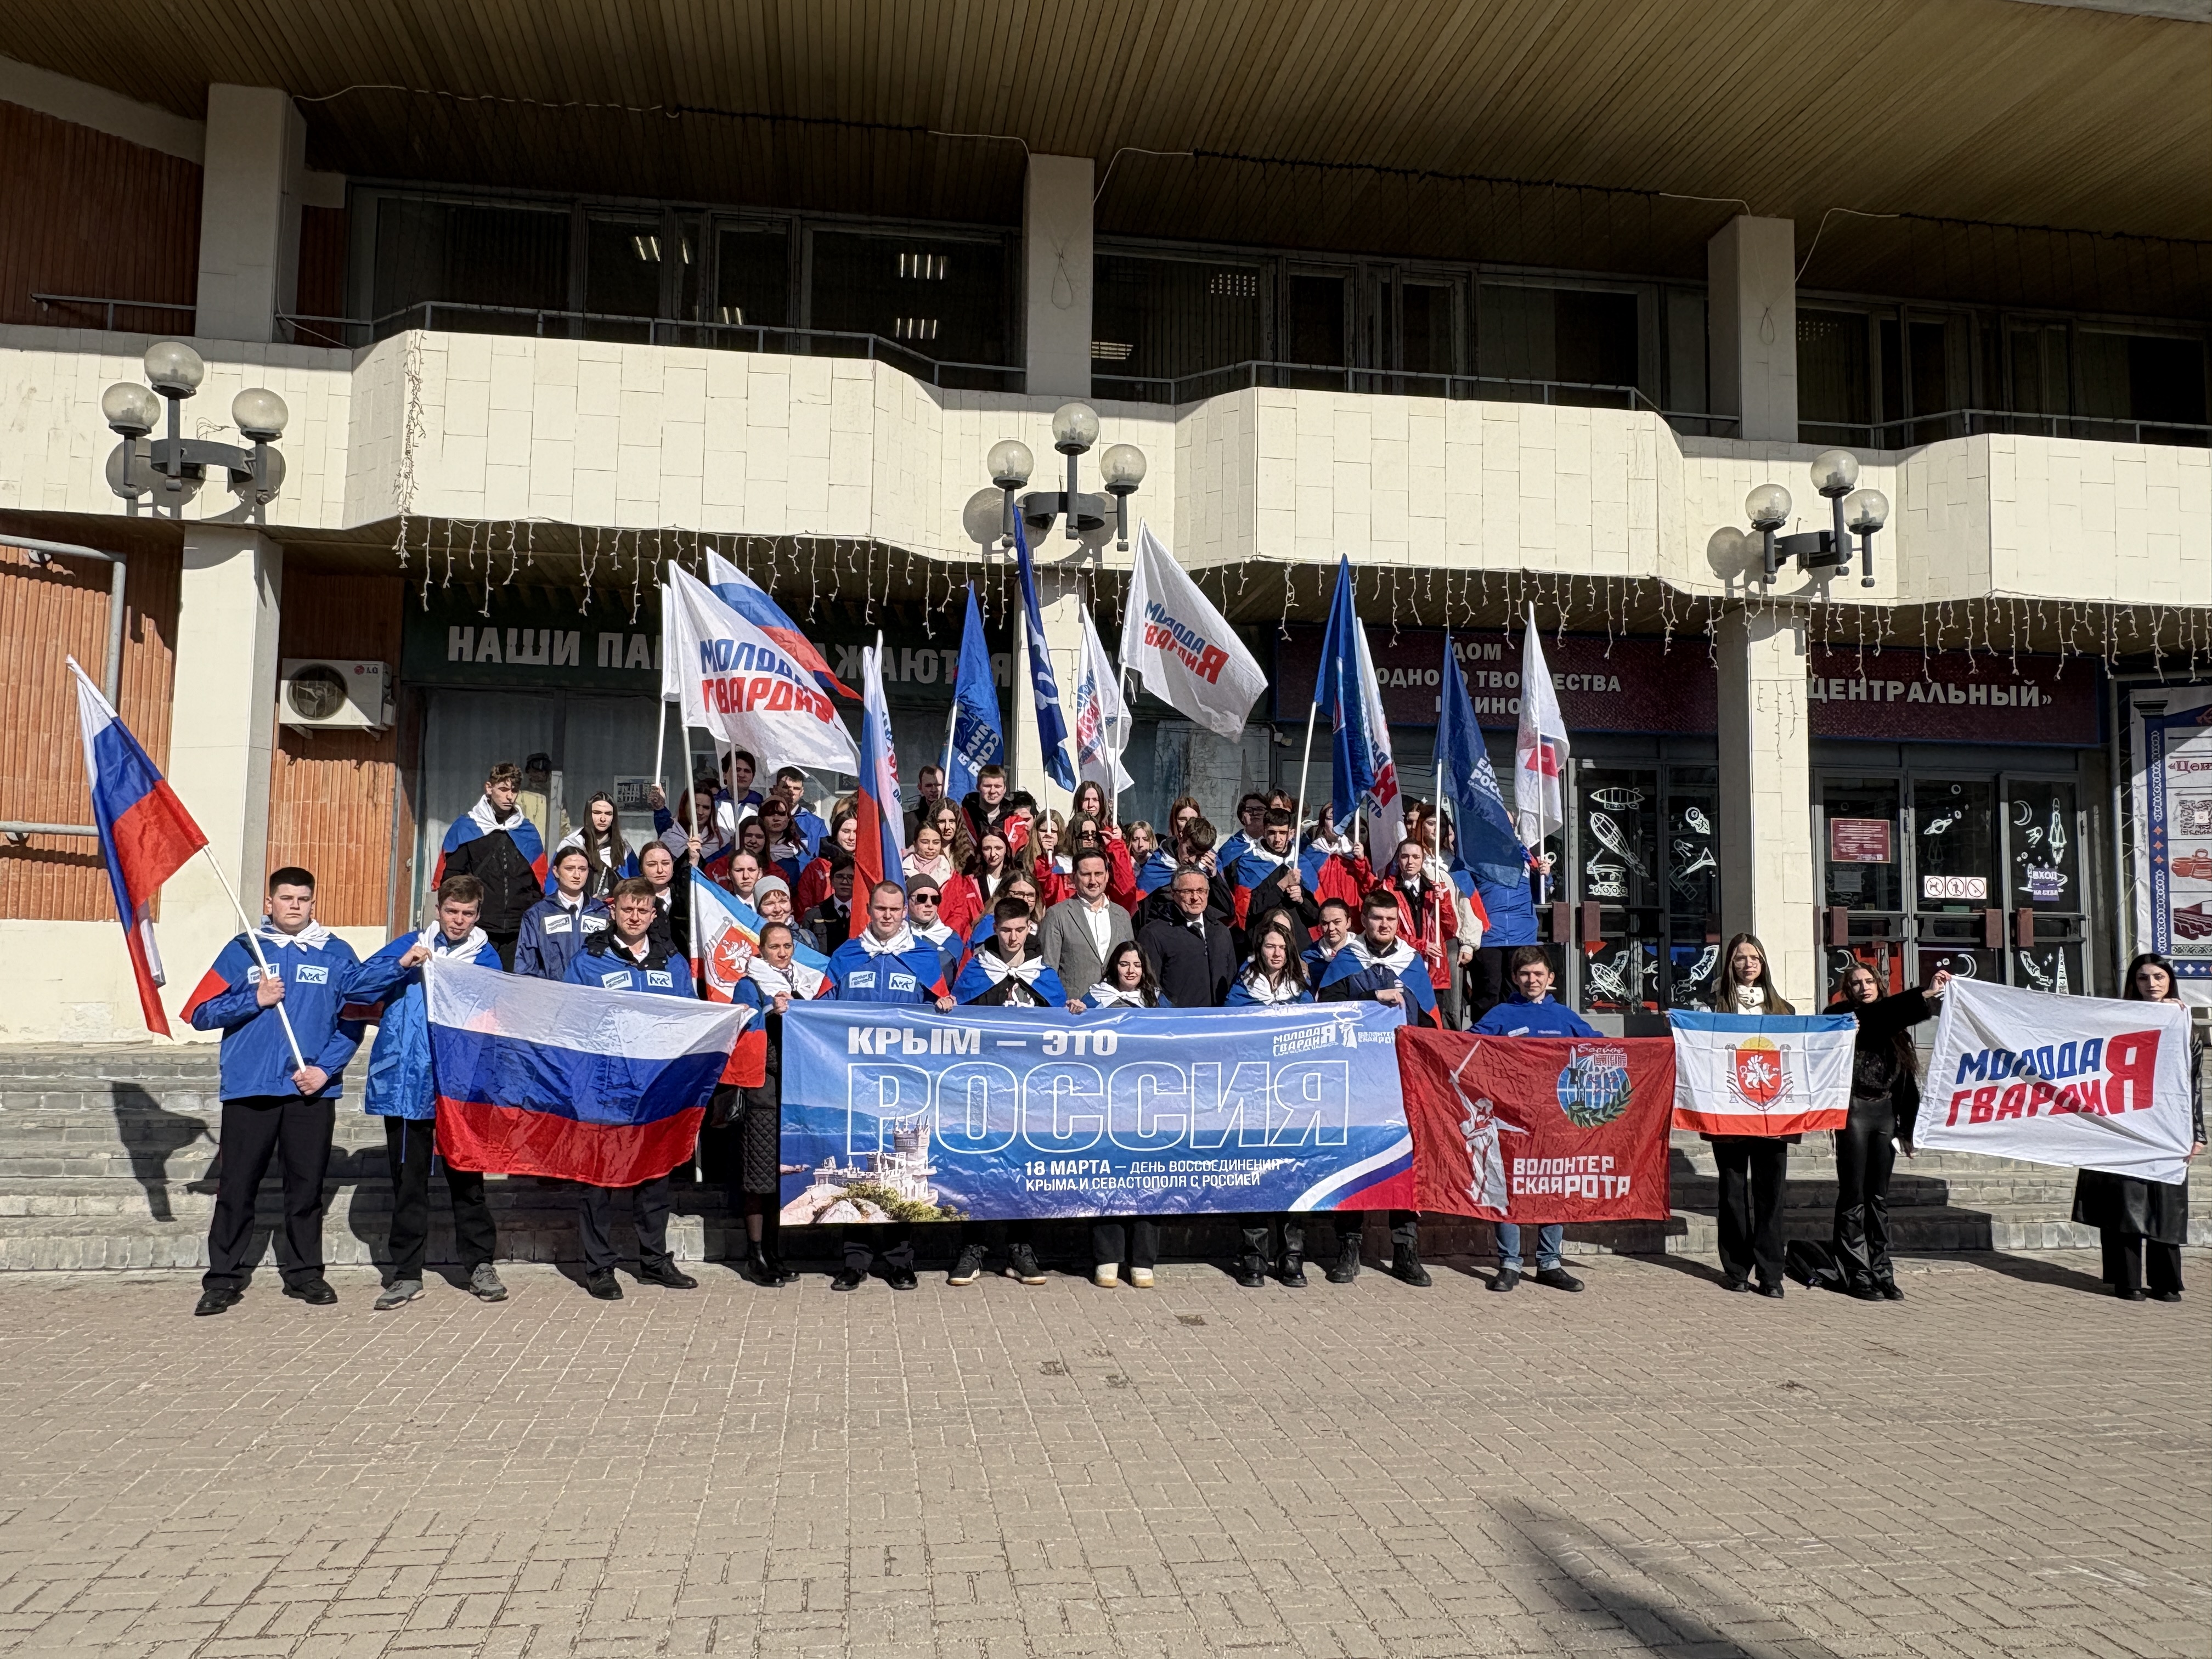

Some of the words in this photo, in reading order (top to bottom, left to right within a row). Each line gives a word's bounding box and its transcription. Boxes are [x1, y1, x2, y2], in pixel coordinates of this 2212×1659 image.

[448, 626, 580, 667] НАШИ
[1453, 642, 1502, 662] ДОМ
[1477, 670, 1621, 692] ТВОЕСТВА
[1471, 696, 1522, 714] ИНО
[2033, 871, 2058, 881] ВХОД
[848, 1027, 981, 1055] КРЫМ
[1042, 1029, 1118, 1056] ЭТО
[847, 1060, 1349, 1155] РОССИЯ
[1025, 1160, 1046, 1176] 18
[1051, 1159, 1111, 1175] МАРТА
[1130, 1161, 1165, 1174] ДЕНЬ
[1514, 1155, 1615, 1175] ВОЛОНТЕР
[1025, 1178, 1076, 1192] КРЫМА
[1079, 1177, 1088, 1190] И
[1092, 1175, 1187, 1190] СЕВАСТОПОЛЯ
[1190, 1175, 1199, 1188] С
[1202, 1171, 1261, 1188] РОССИЕЙ
